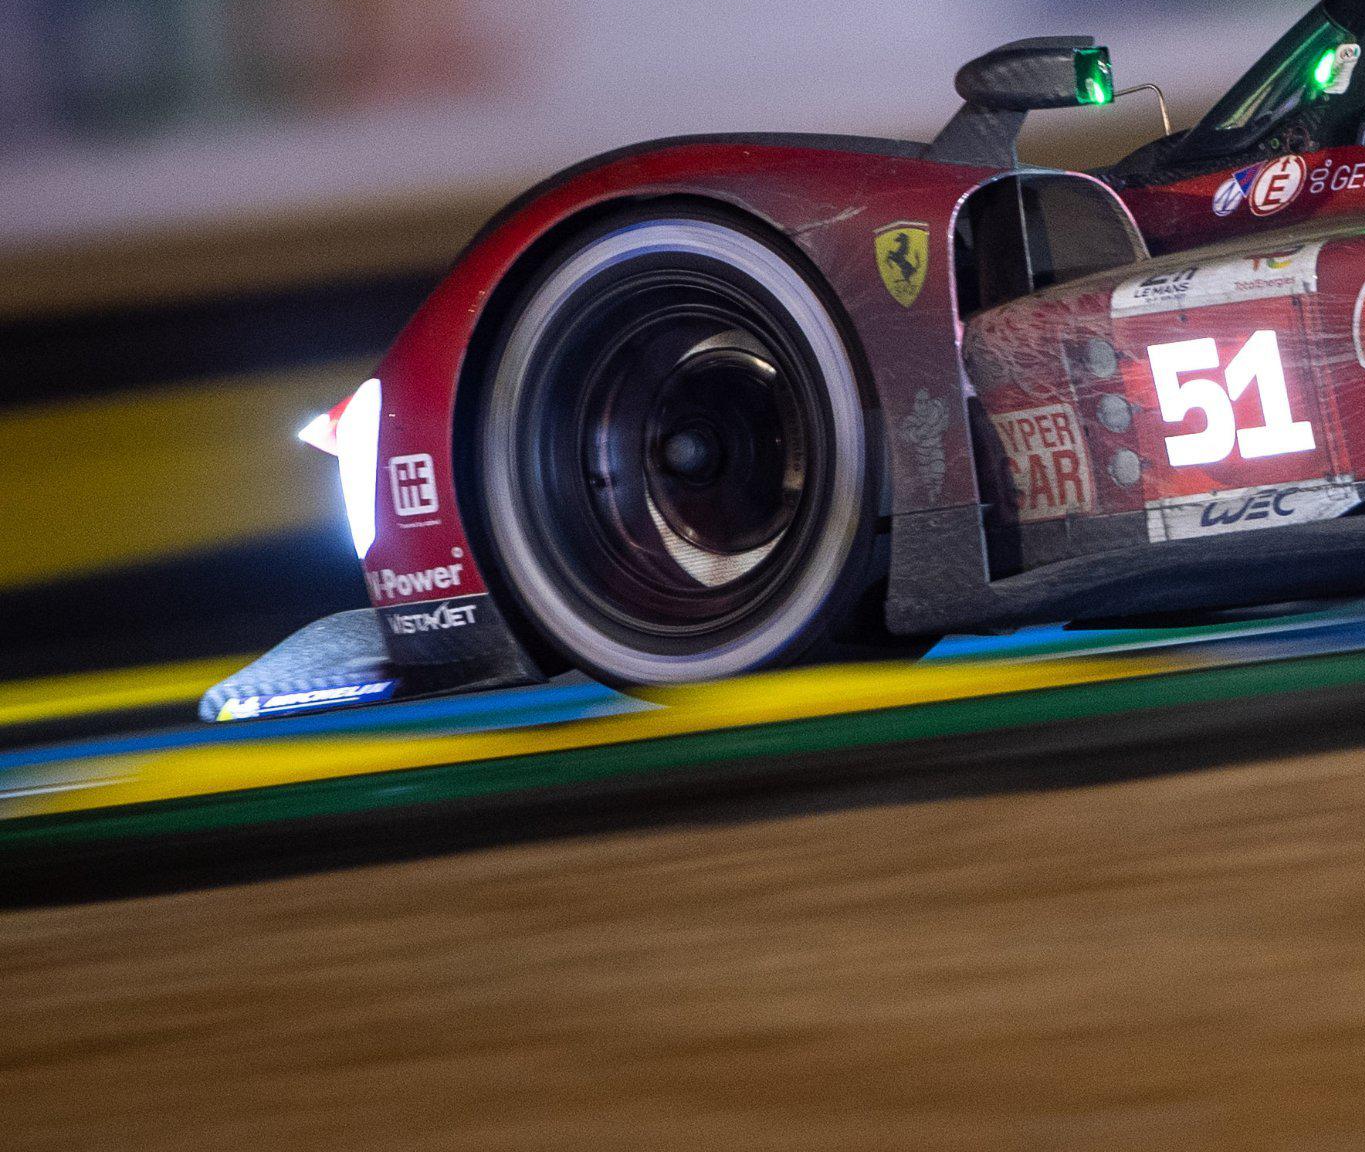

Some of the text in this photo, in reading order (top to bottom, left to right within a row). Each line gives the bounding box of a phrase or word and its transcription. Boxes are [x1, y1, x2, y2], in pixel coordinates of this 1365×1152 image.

[1261, 173, 1291, 206] E
[1146, 328, 1317, 468] 51
[998, 412, 1077, 453] YPER
[1200, 487, 1300, 528] WEC
